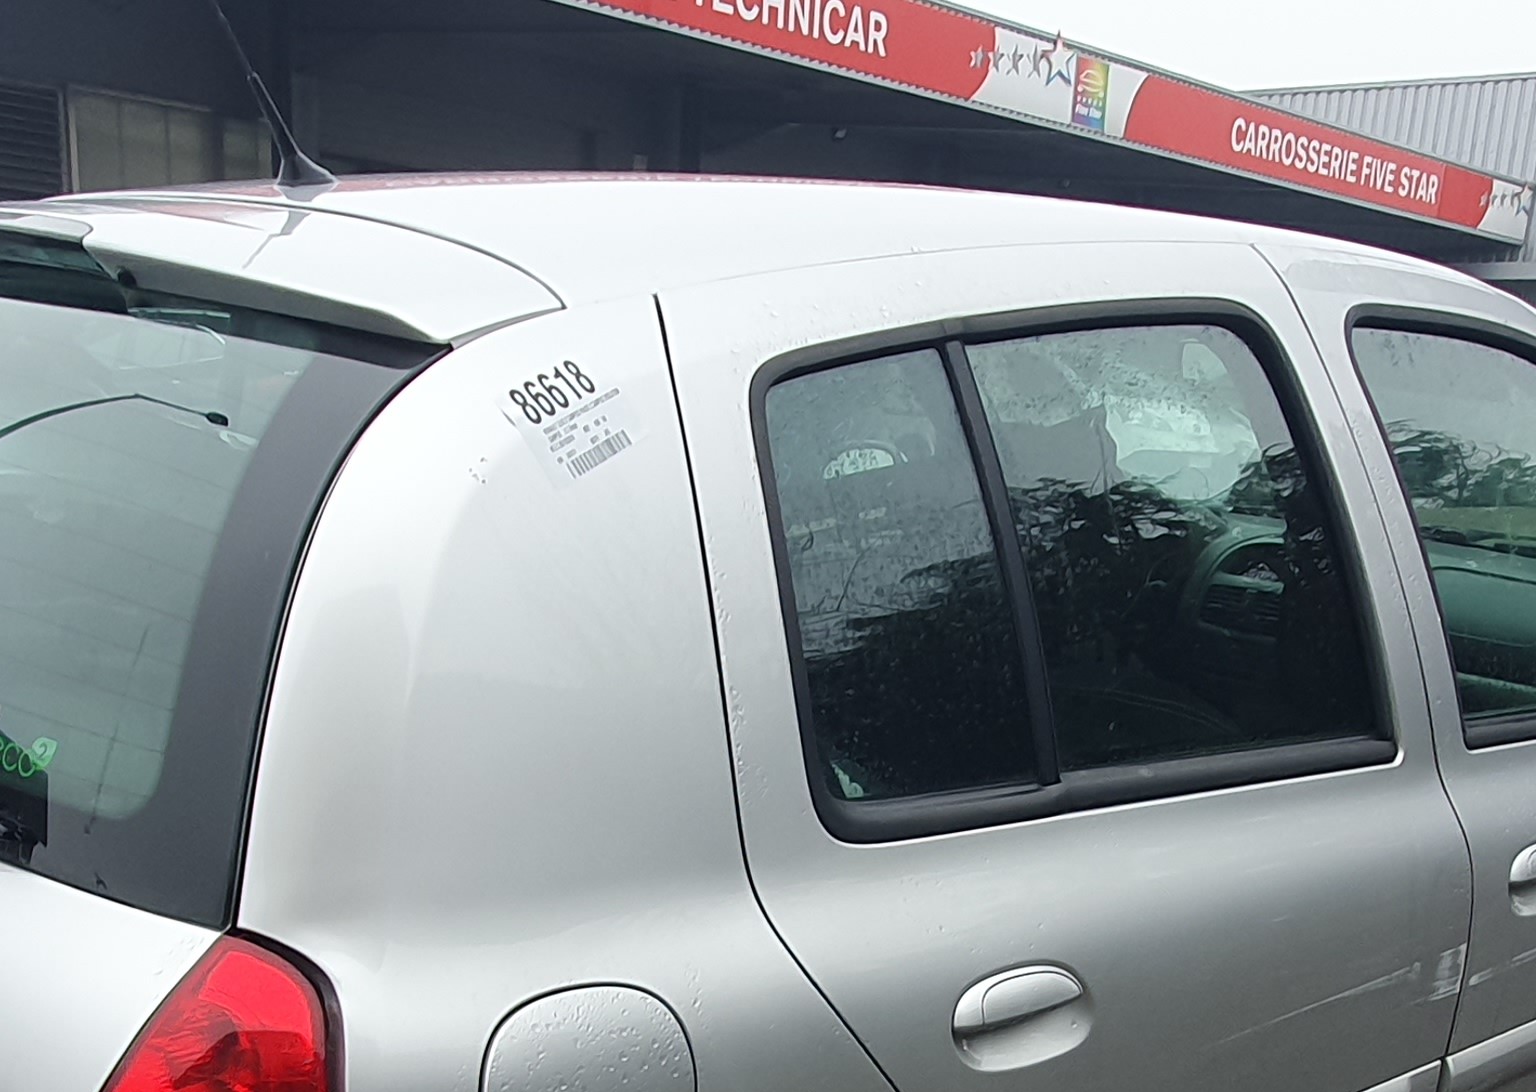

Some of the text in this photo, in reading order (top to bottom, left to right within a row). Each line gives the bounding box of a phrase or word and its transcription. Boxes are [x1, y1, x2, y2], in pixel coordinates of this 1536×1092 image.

[695, 0, 888, 57] HNICAR
[1231, 117, 1439, 204] CARROSSERIE FIVE STAR
[509, 360, 595, 424] 86618
